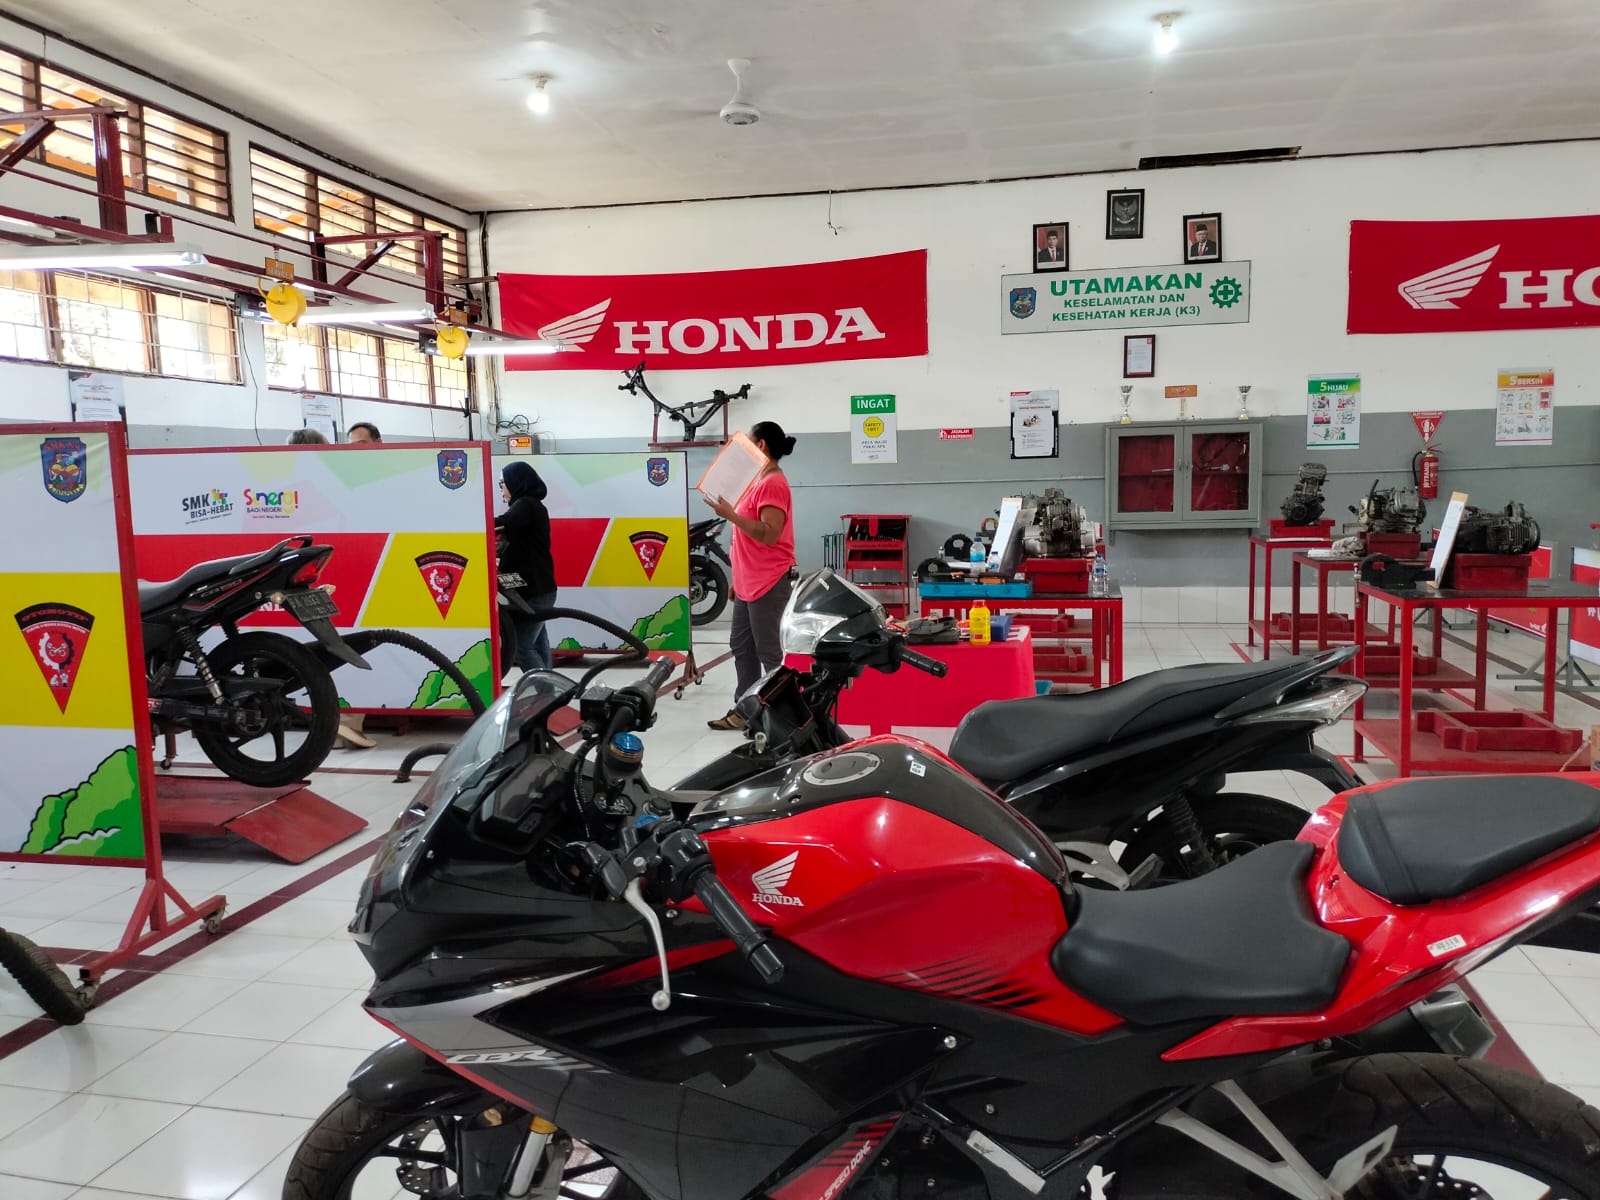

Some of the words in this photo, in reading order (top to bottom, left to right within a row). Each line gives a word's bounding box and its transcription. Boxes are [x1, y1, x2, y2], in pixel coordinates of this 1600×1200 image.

[1051, 272, 1202, 296] UTAMAKAN
[1064, 295, 1155, 308] KESELAMATAN
[1159, 293, 1185, 303] DAN
[1052, 308, 1126, 321] KESEHATAN
[1130, 307, 1171, 318] KERJA
[1175, 305, 1201, 318] (K3)
[614, 306, 885, 355] HONDA
[1320, 381, 1327, 392] 5
[856, 398, 890, 409] INGAT
[182, 493, 210, 512] SMK
[190, 503, 233, 519] BISA-HEBAT
[752, 892, 804, 907] HONDA
[446, 1049, 556, 1064] CBR
